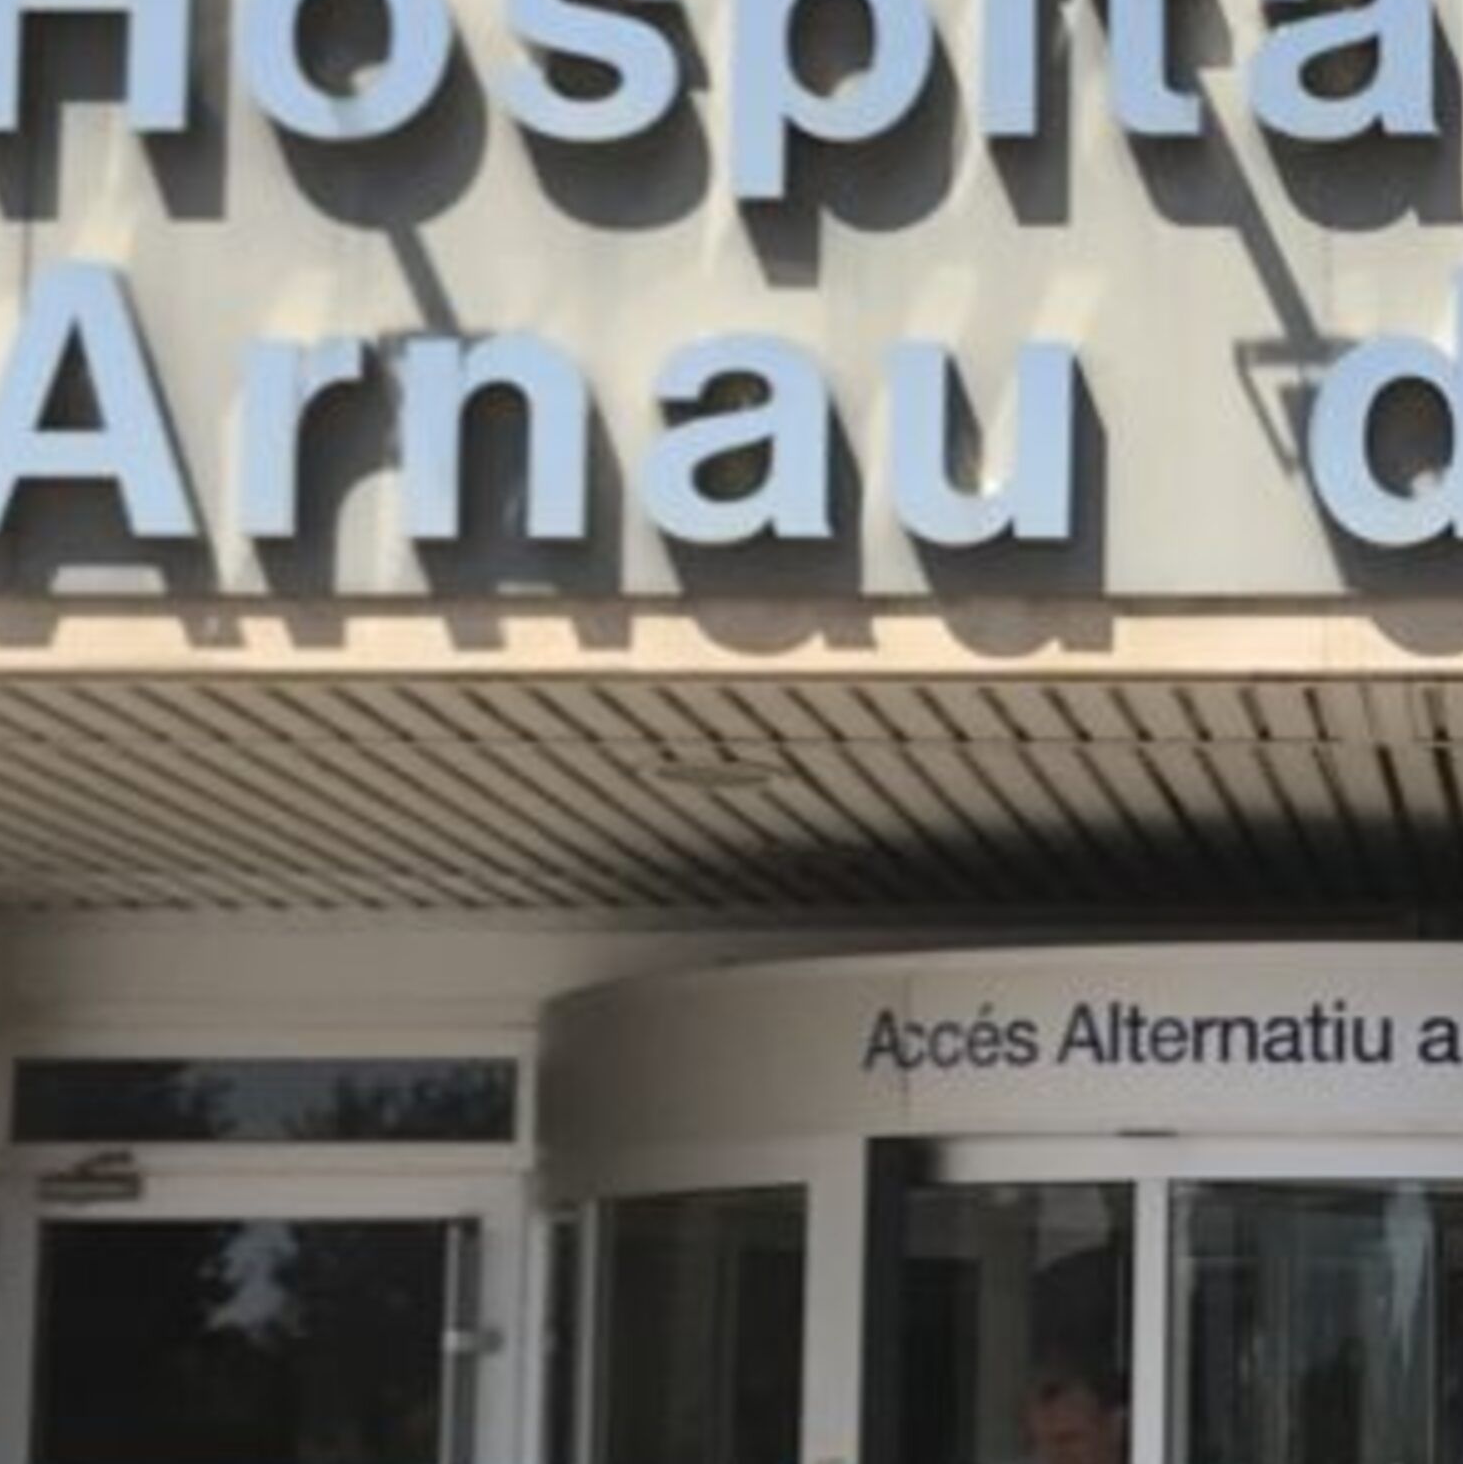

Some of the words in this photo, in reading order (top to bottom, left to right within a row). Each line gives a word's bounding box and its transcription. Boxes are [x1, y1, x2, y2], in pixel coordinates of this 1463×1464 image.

[861, 1001, 1039, 1070] Accés
[1057, 1000, 1394, 1067] Alternatiu
[1416, 1013, 1463, 1067] a
